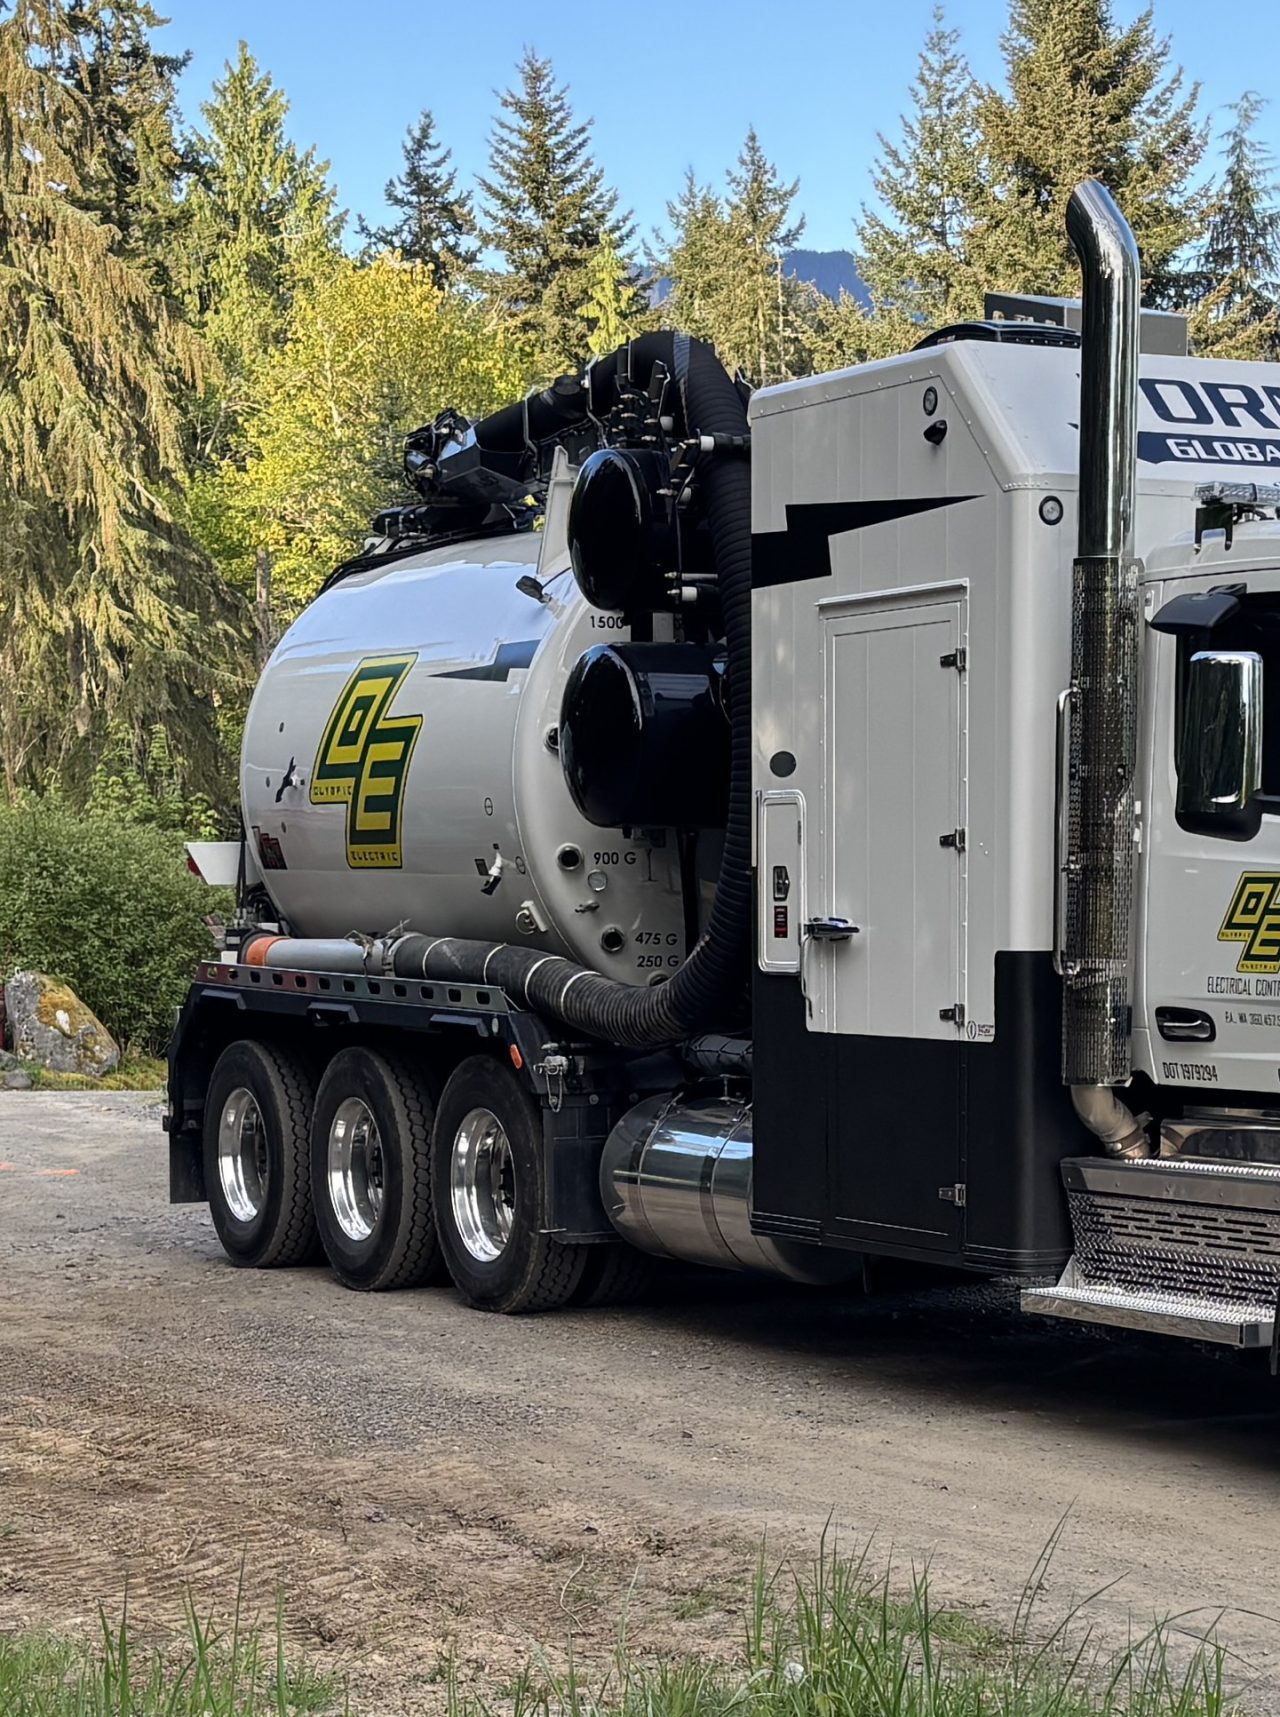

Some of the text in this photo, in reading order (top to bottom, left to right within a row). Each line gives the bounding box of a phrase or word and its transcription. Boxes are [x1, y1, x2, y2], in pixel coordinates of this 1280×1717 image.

[590, 615, 624, 629] 1500
[350, 850, 398, 861] ELECTRIC
[594, 851, 637, 865] 900 G
[635, 932, 678, 946] 475 G
[637, 955, 679, 968] 250 G
[1207, 976, 1251, 995] ELECTRICAL
[1162, 1062, 1218, 1082] DOT 1979294
